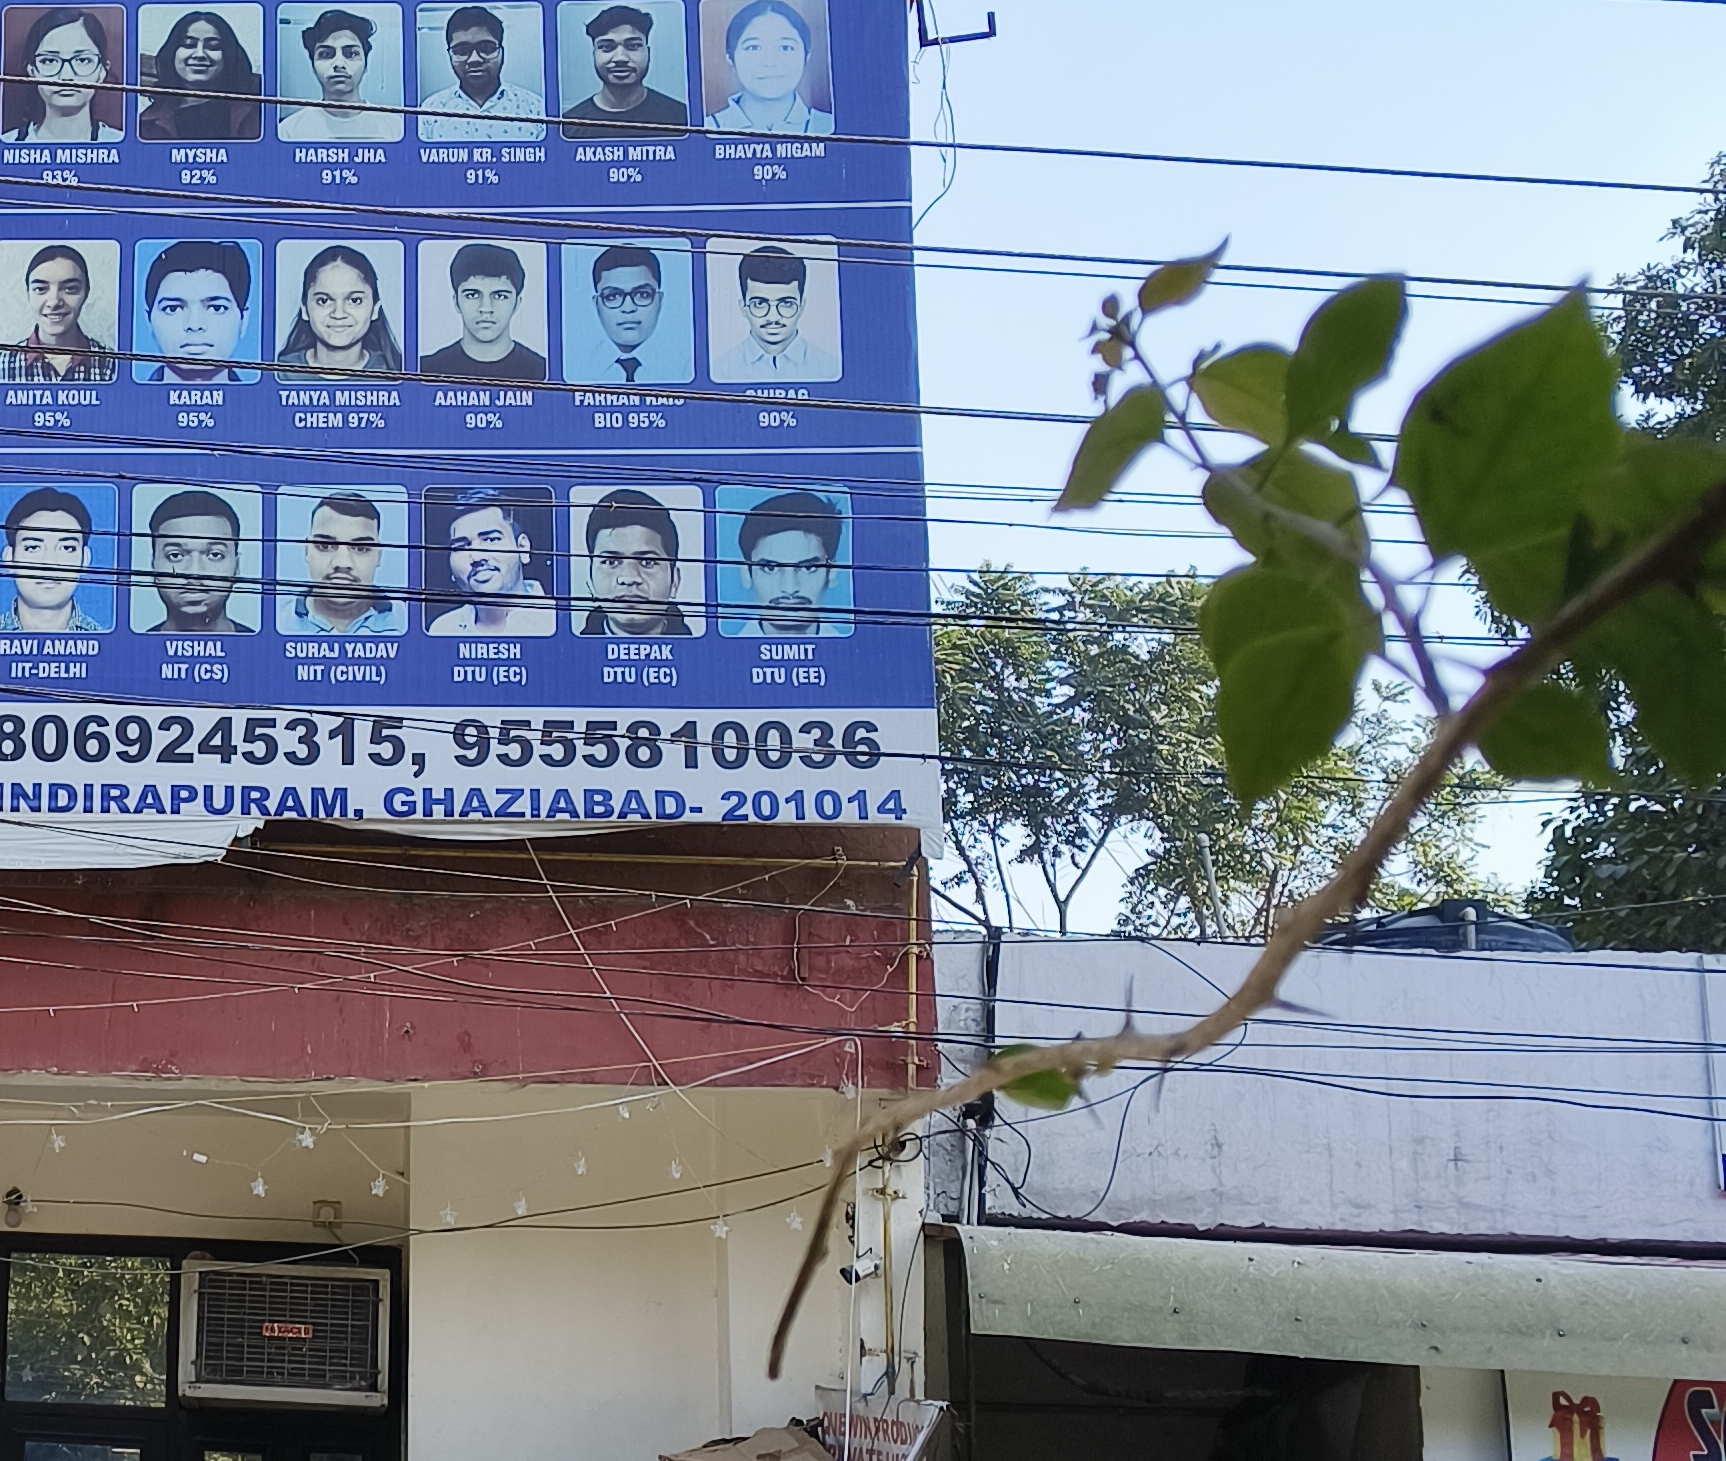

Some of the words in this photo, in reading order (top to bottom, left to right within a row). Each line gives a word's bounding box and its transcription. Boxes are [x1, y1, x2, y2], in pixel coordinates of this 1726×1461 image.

[3, 148, 51, 164] NISHA
[55, 148, 120, 164] MISHRA
[169, 148, 229, 163] MYSHA
[294, 148, 348, 163] HARSH
[353, 148, 387, 163] JHA
[418, 147, 470, 163] VARUN
[500, 146, 546, 163] SINGH
[574, 146, 622, 162] AKASH
[627, 146, 676, 161] MITRA
[714, 143, 773, 160] BHAVYA
[775, 142, 826, 159] NIGAM
[180, 169, 218, 184] 92%
[320, 169, 359, 185] 91%
[465, 168, 501, 185] 91%
[609, 167, 643, 183] 90%
[752, 165, 788, 181] 90%
[5, 390, 53, 406] ANITA
[57, 390, 101, 406] KOUL
[168, 390, 225, 406] KARAN
[279, 390, 330, 406] TANYA
[335, 390, 402, 406] MISHRA
[433, 390, 491, 407] AAHAN
[495, 390, 534, 406] JAIN
[33, 411, 71, 427] 95%
[177, 411, 215, 428] 95%
[294, 412, 343, 429] CHEM
[348, 412, 386, 429] 97%
[465, 412, 503, 429] 90%
[593, 412, 625, 429] BIO
[628, 411, 667, 428] 95%
[758, 411, 798, 428] 90%
[0, 640, 38, 655] RAVI
[42, 640, 100, 655] ANAND
[165, 640, 226, 657] VISHAL
[284, 642, 340, 658] SURAJ
[344, 642, 399, 658] YADAV
[458, 643, 522, 659] NIRESH
[606, 643, 674, 660] DEEPAK
[759, 644, 816, 660] SUMIT
[161, 663, 191, 679] NIT
[296, 665, 325, 681] NIT
[329, 665, 387, 684] (CIVIL)
[451, 666, 487, 682] DTU
[492, 666, 528, 685] (EC)
[602, 667, 637, 683] DTU
[642, 666, 678, 686] (EC)
[751, 667, 786, 683] DTU
[791, 667, 827, 686] (EE)
[452, 719, 882, 770] 9555810036
[720, 788, 907, 823] 201014
